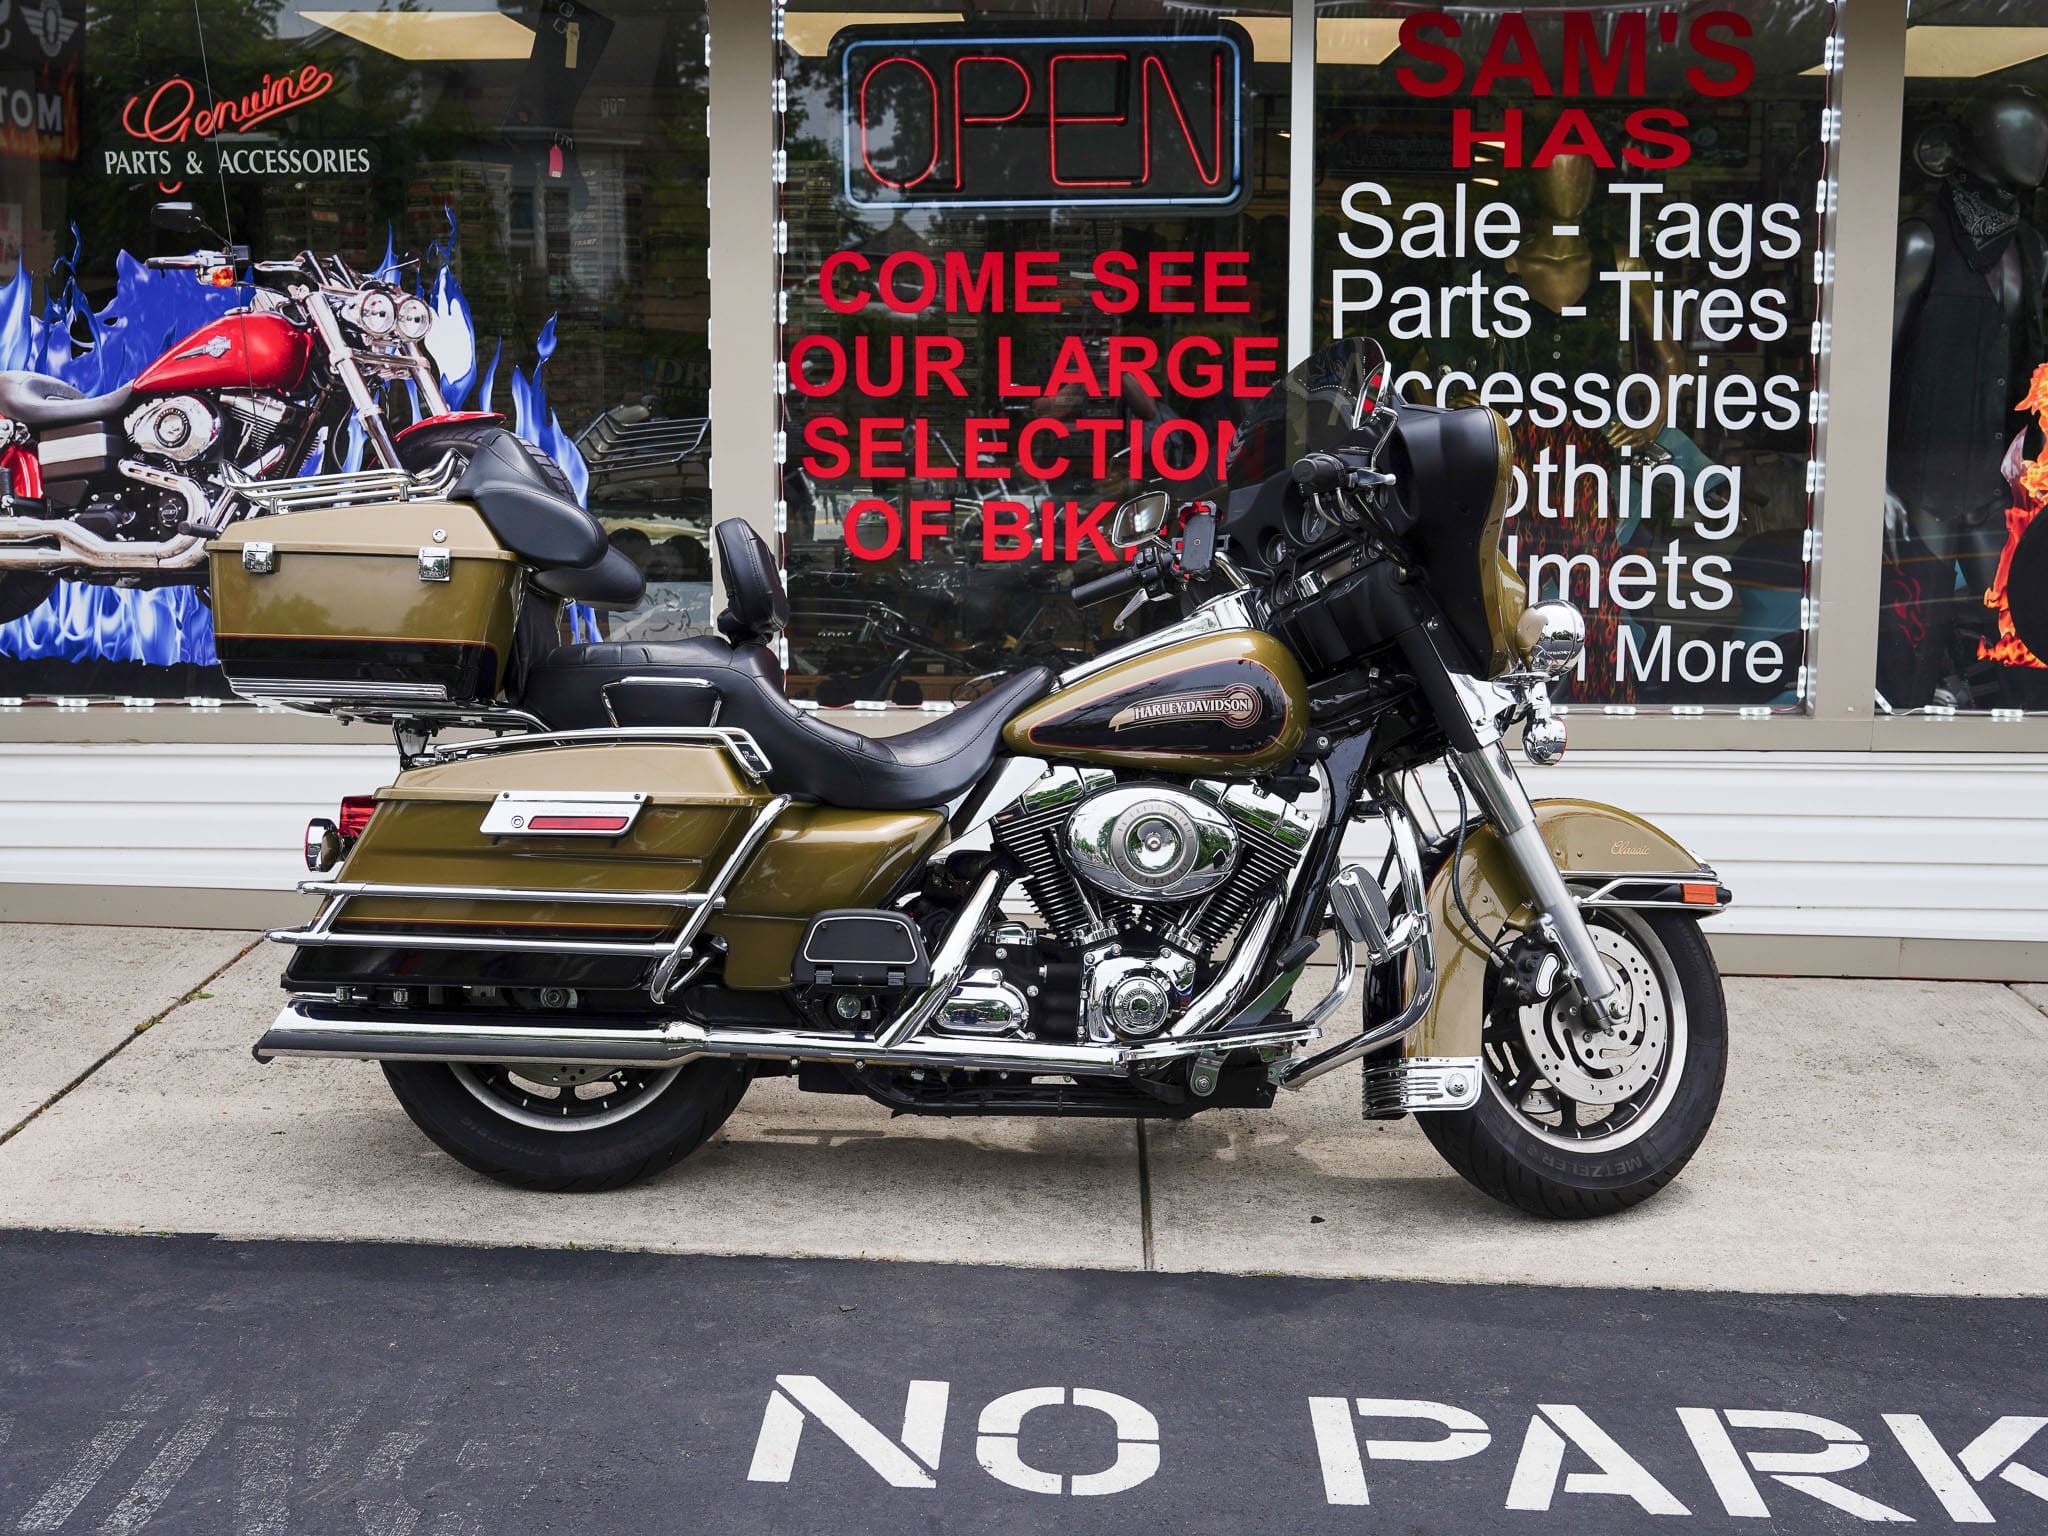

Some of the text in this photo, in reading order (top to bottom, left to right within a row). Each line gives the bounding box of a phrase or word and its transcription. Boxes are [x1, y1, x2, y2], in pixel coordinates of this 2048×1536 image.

[1396, 10, 1754, 97] SAM'S
[122, 65, 334, 143] Genuine
[861, 54, 1221, 189] OPEN
[105, 148, 370, 175] PARTS & ACCESSORIES
[1452, 108, 1691, 169] HAS
[1338, 181, 1521, 259] Sale
[1609, 183, 1802, 280] Tags
[818, 250, 1250, 314] COME SEE
[1332, 269, 1532, 339] Parts
[1600, 270, 1788, 342] Tires
[788, 335, 1279, 399] OUR LARGE
[1394, 355, 1800, 431] ccessories
[843, 498, 1172, 563] OF BIK
[1616, 624, 1784, 684] More
[1611, 840, 1649, 855] Classic
[1541, 1152, 1644, 1178] METZELER
[747, 1375, 2048, 1522] NO PARK
